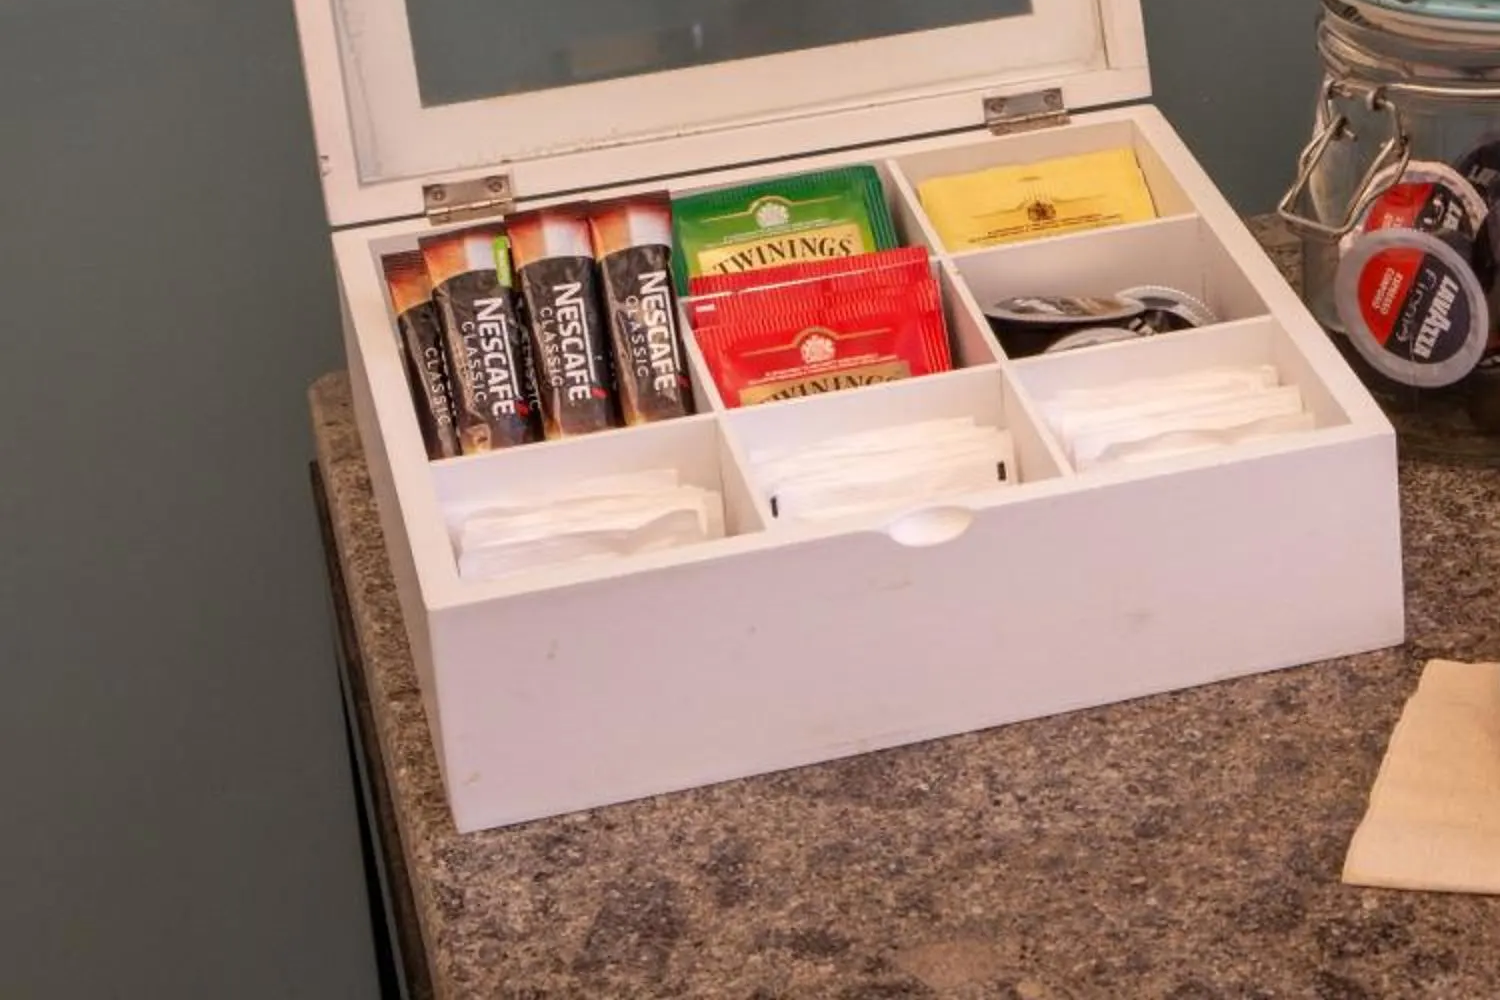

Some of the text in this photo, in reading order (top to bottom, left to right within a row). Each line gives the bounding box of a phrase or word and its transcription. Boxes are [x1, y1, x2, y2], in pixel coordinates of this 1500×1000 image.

[712, 236, 853, 275] TWININGS
[540, 306, 563, 387] CLASSIC
[625, 295, 649, 377] CLASSIC
[1413, 274, 1461, 360] LAVAZZA
[424, 347, 451, 425] CLASSIC
[461, 320, 487, 402] CLASSIC
